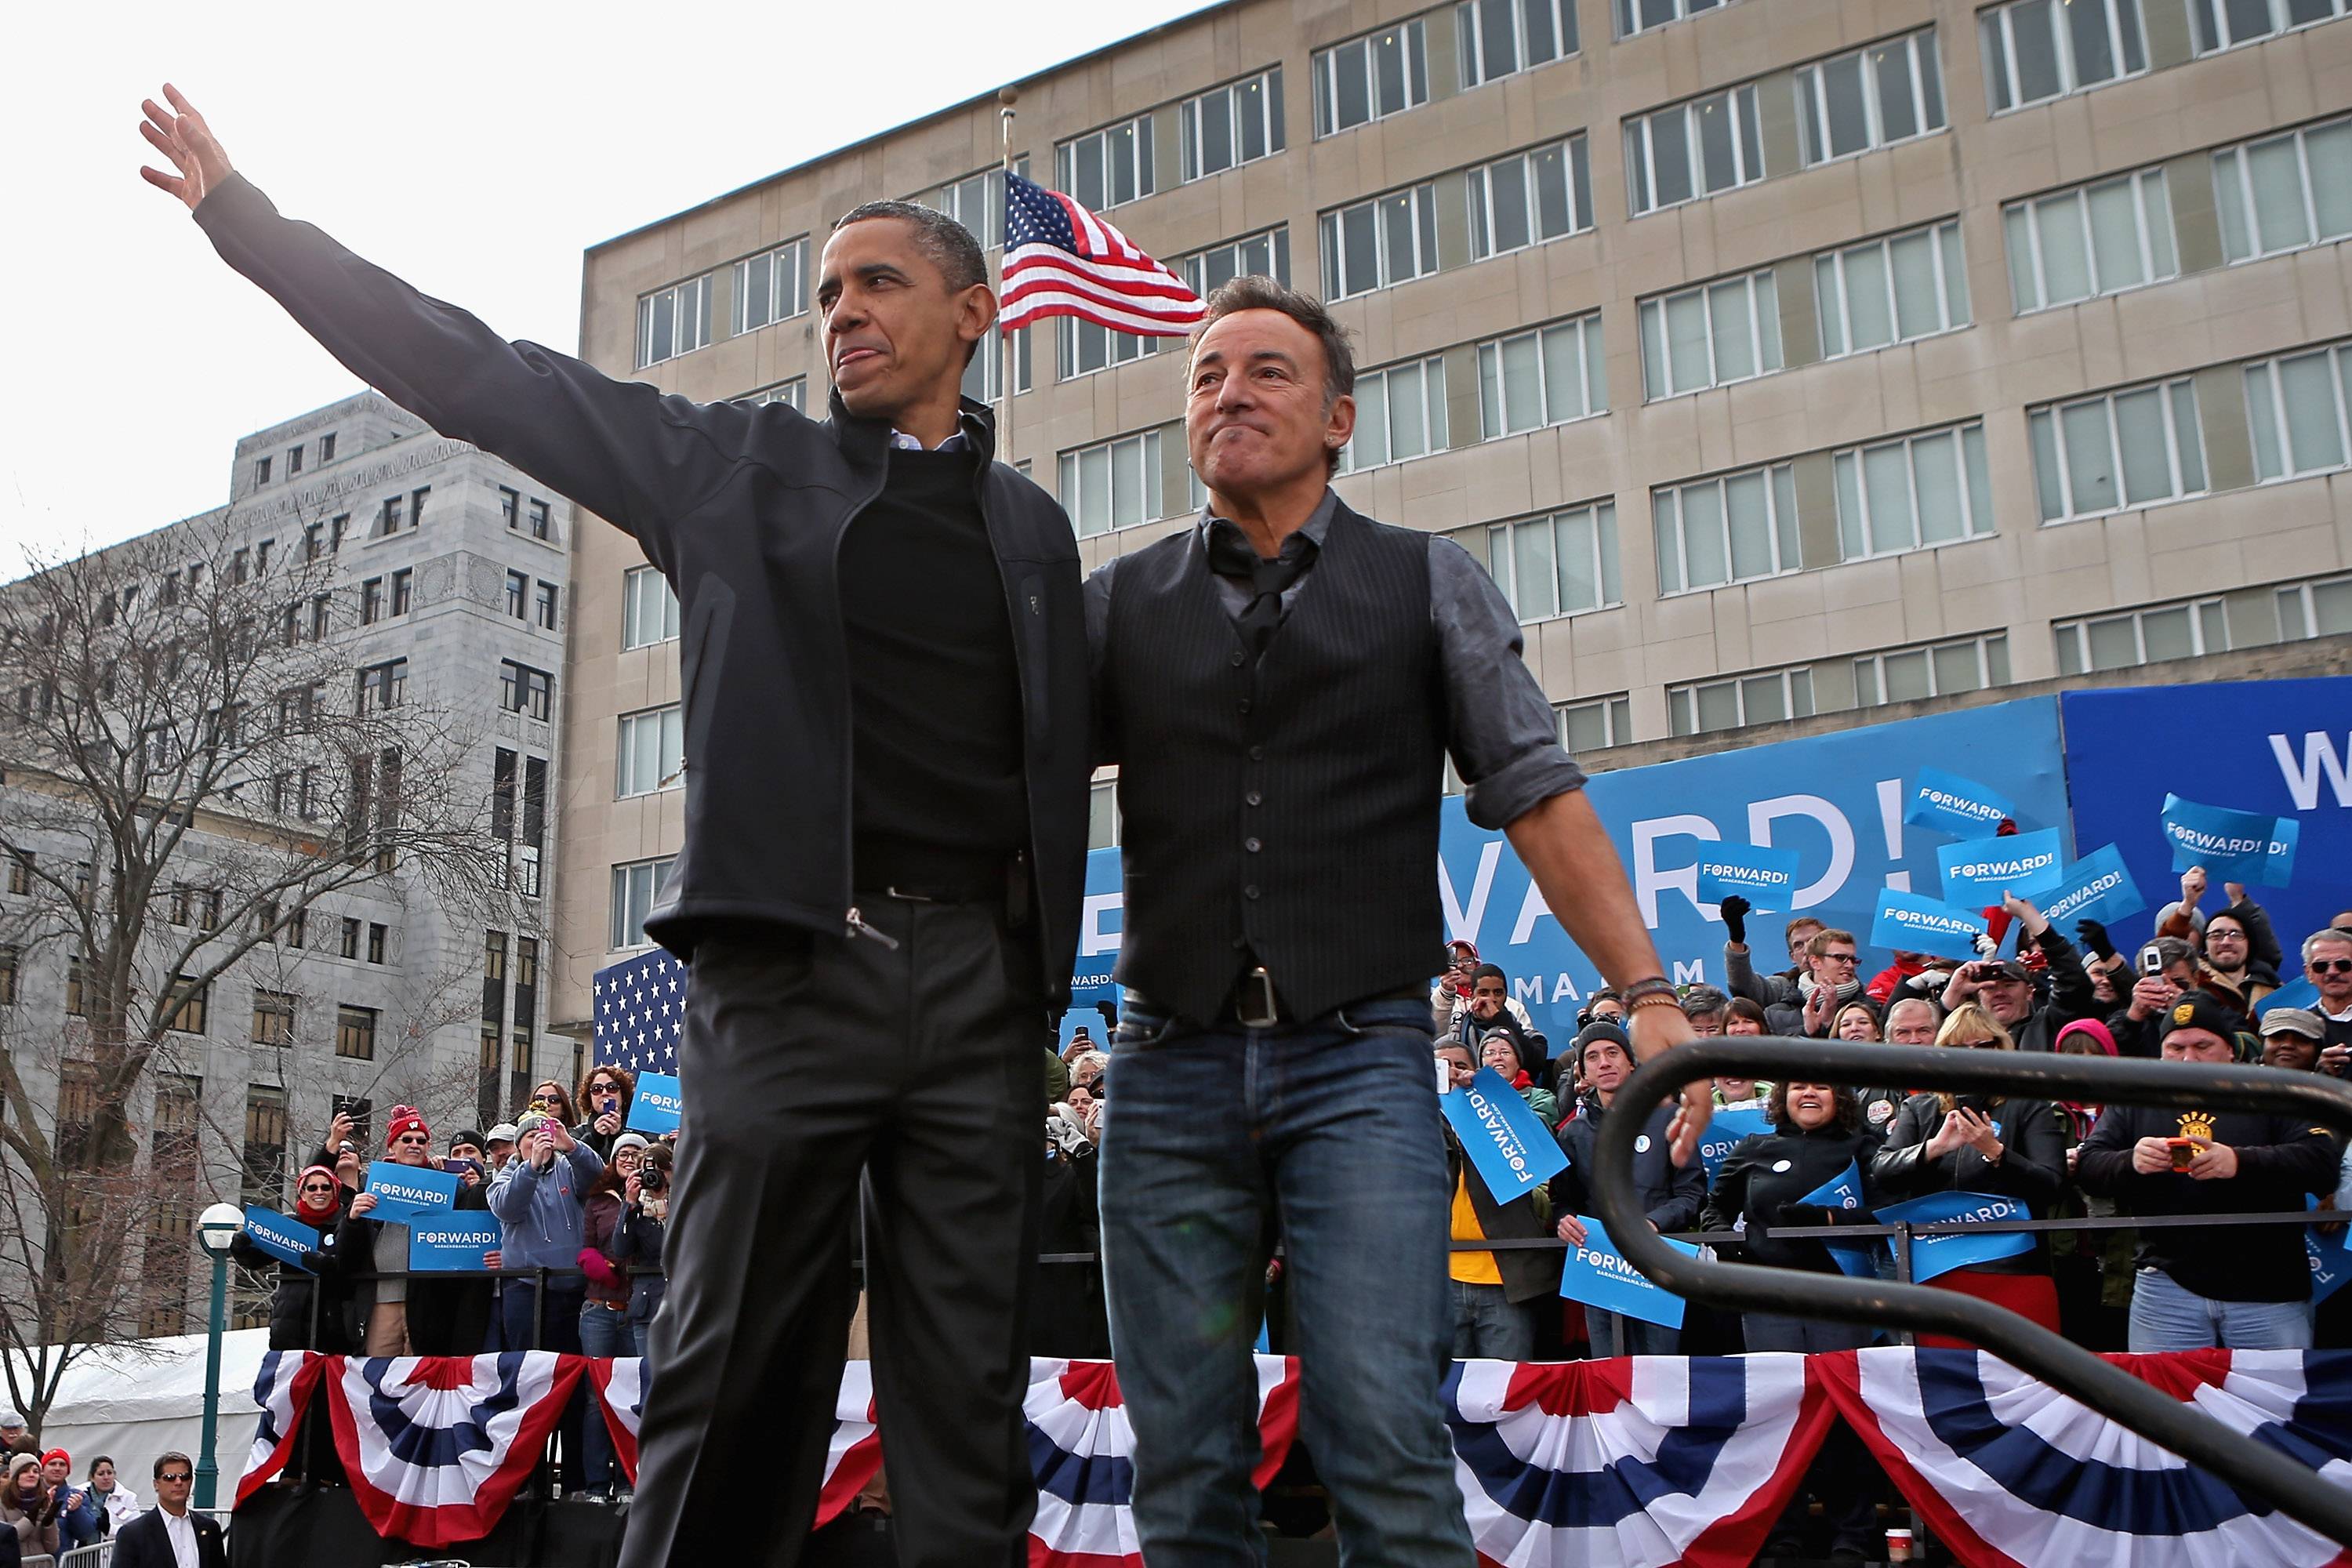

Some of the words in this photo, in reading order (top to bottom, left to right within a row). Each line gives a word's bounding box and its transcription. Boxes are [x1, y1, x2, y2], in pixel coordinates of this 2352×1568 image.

[2167, 822, 2262, 853] FORWARD!
[1702, 863, 1788, 885] FORWARD!
[1950, 852, 2053, 879] FORWARD!
[1465, 1087, 1534, 1183] FORWARD!
[371, 1181, 448, 1205] FORWARD!
[417, 1232, 495, 1243] FORWARD!
